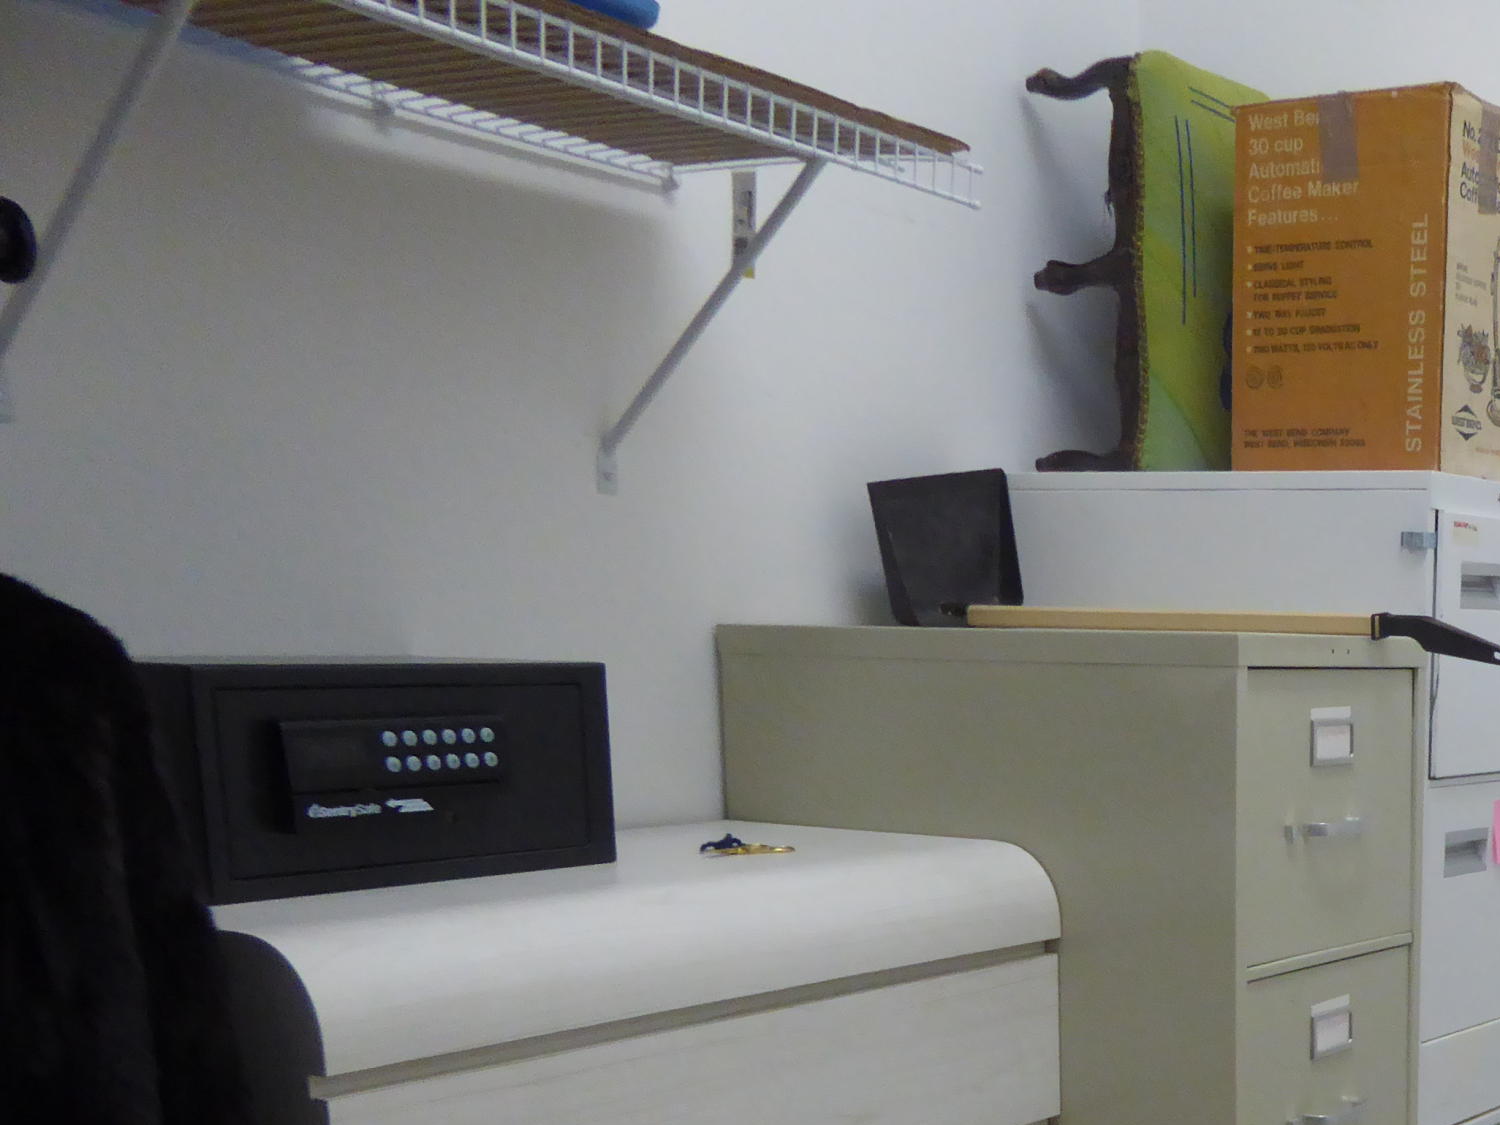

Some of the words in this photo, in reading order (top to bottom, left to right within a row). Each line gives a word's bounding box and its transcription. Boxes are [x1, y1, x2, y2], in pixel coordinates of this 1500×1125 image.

[1248, 112, 1288, 131] West
[1294, 109, 1320, 126] Be
[1463, 120, 1477, 142] No.
[1249, 138, 1269, 155] 30
[1275, 138, 1303, 153] cup
[1249, 158, 1320, 179] Automati
[1248, 184, 1302, 203] Coffee
[1307, 180, 1359, 197] Maker
[1459, 181, 1479, 204] Coff
[1410, 213, 1429, 298] STEEL
[1405, 309, 1426, 452] STAINLESS
